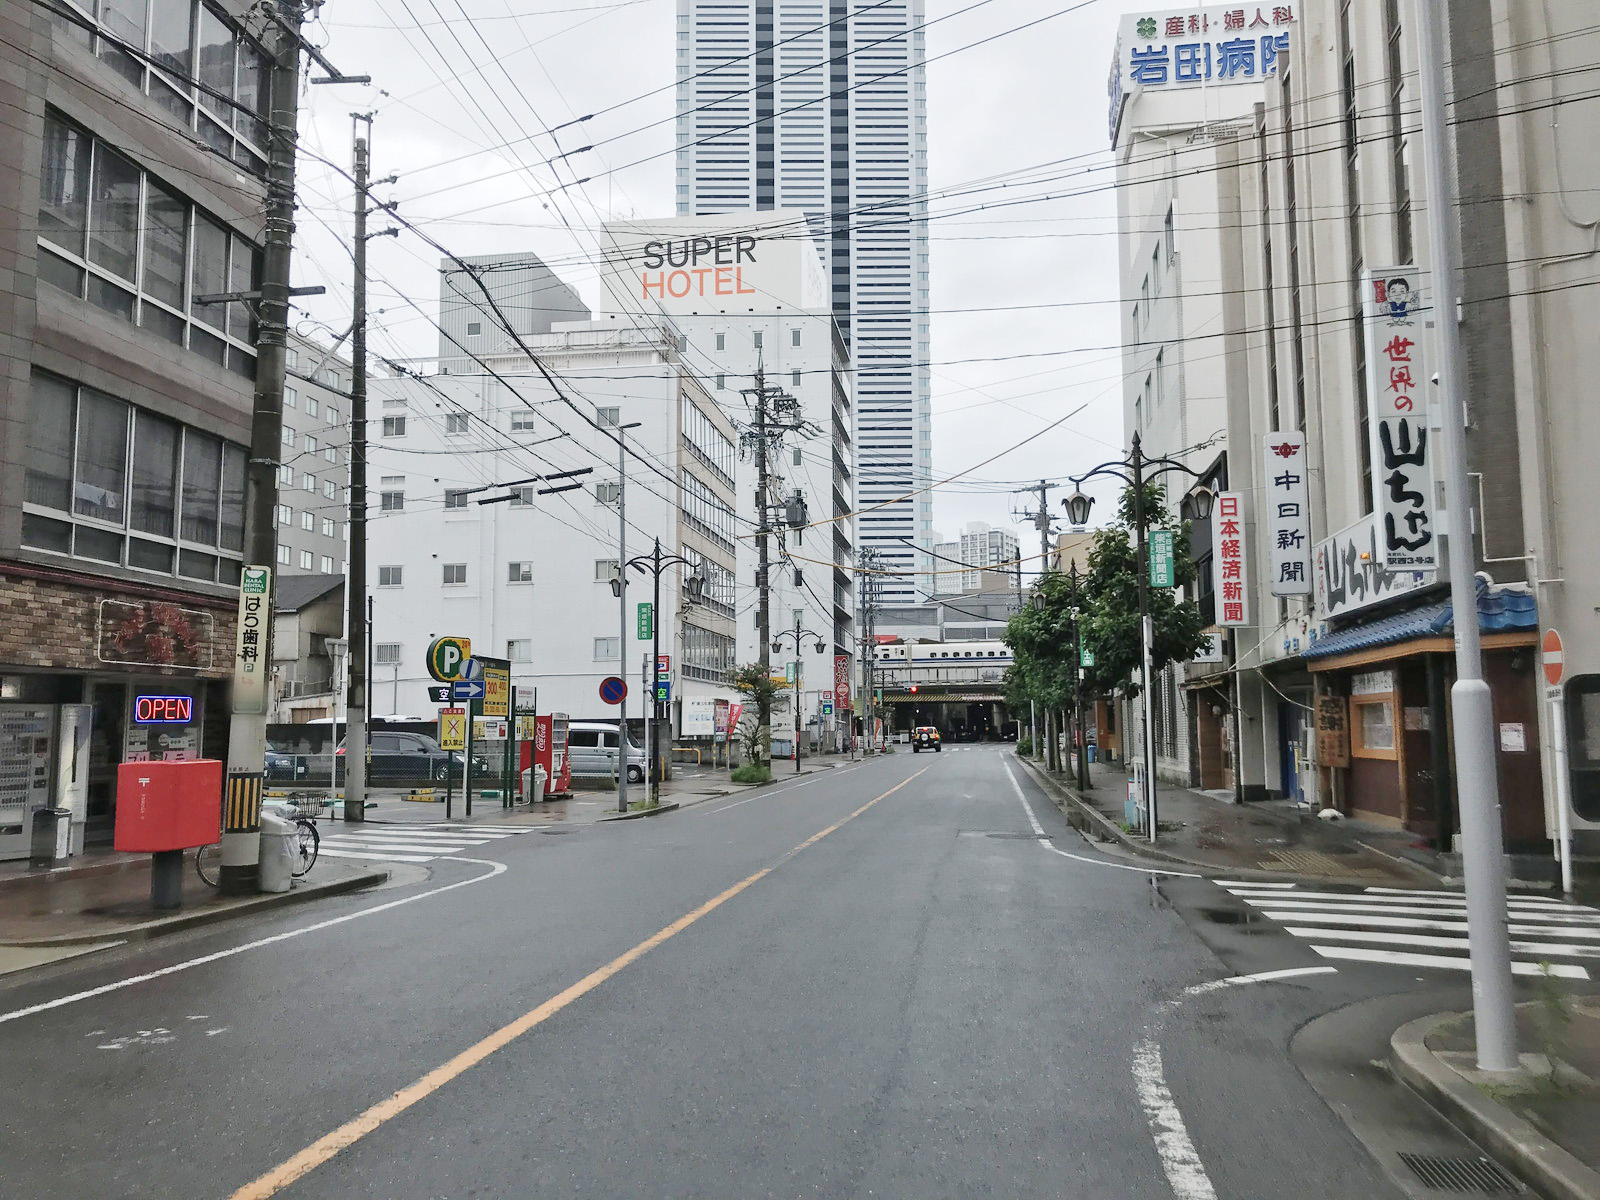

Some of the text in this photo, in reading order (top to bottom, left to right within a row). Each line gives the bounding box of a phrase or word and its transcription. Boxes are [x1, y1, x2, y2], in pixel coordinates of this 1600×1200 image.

[1165, 5, 1294, 38] 産科・婦人科
[643, 235, 757, 270] SUPER
[642, 266, 756, 300] HOTEL
[1382, 334, 1416, 412] 世界の
[1378, 418, 1432, 552] 山ちゃん
[1274, 470, 1305, 583] 中日新聞
[1219, 497, 1243, 622] 日本経済新聞
[242, 596, 261, 663] はら歯科
[443, 645, 460, 674] P
[137, 698, 191, 720] OPEN
[438, 688, 450, 701] 空
[442, 739, 464, 747] 進入禁止
